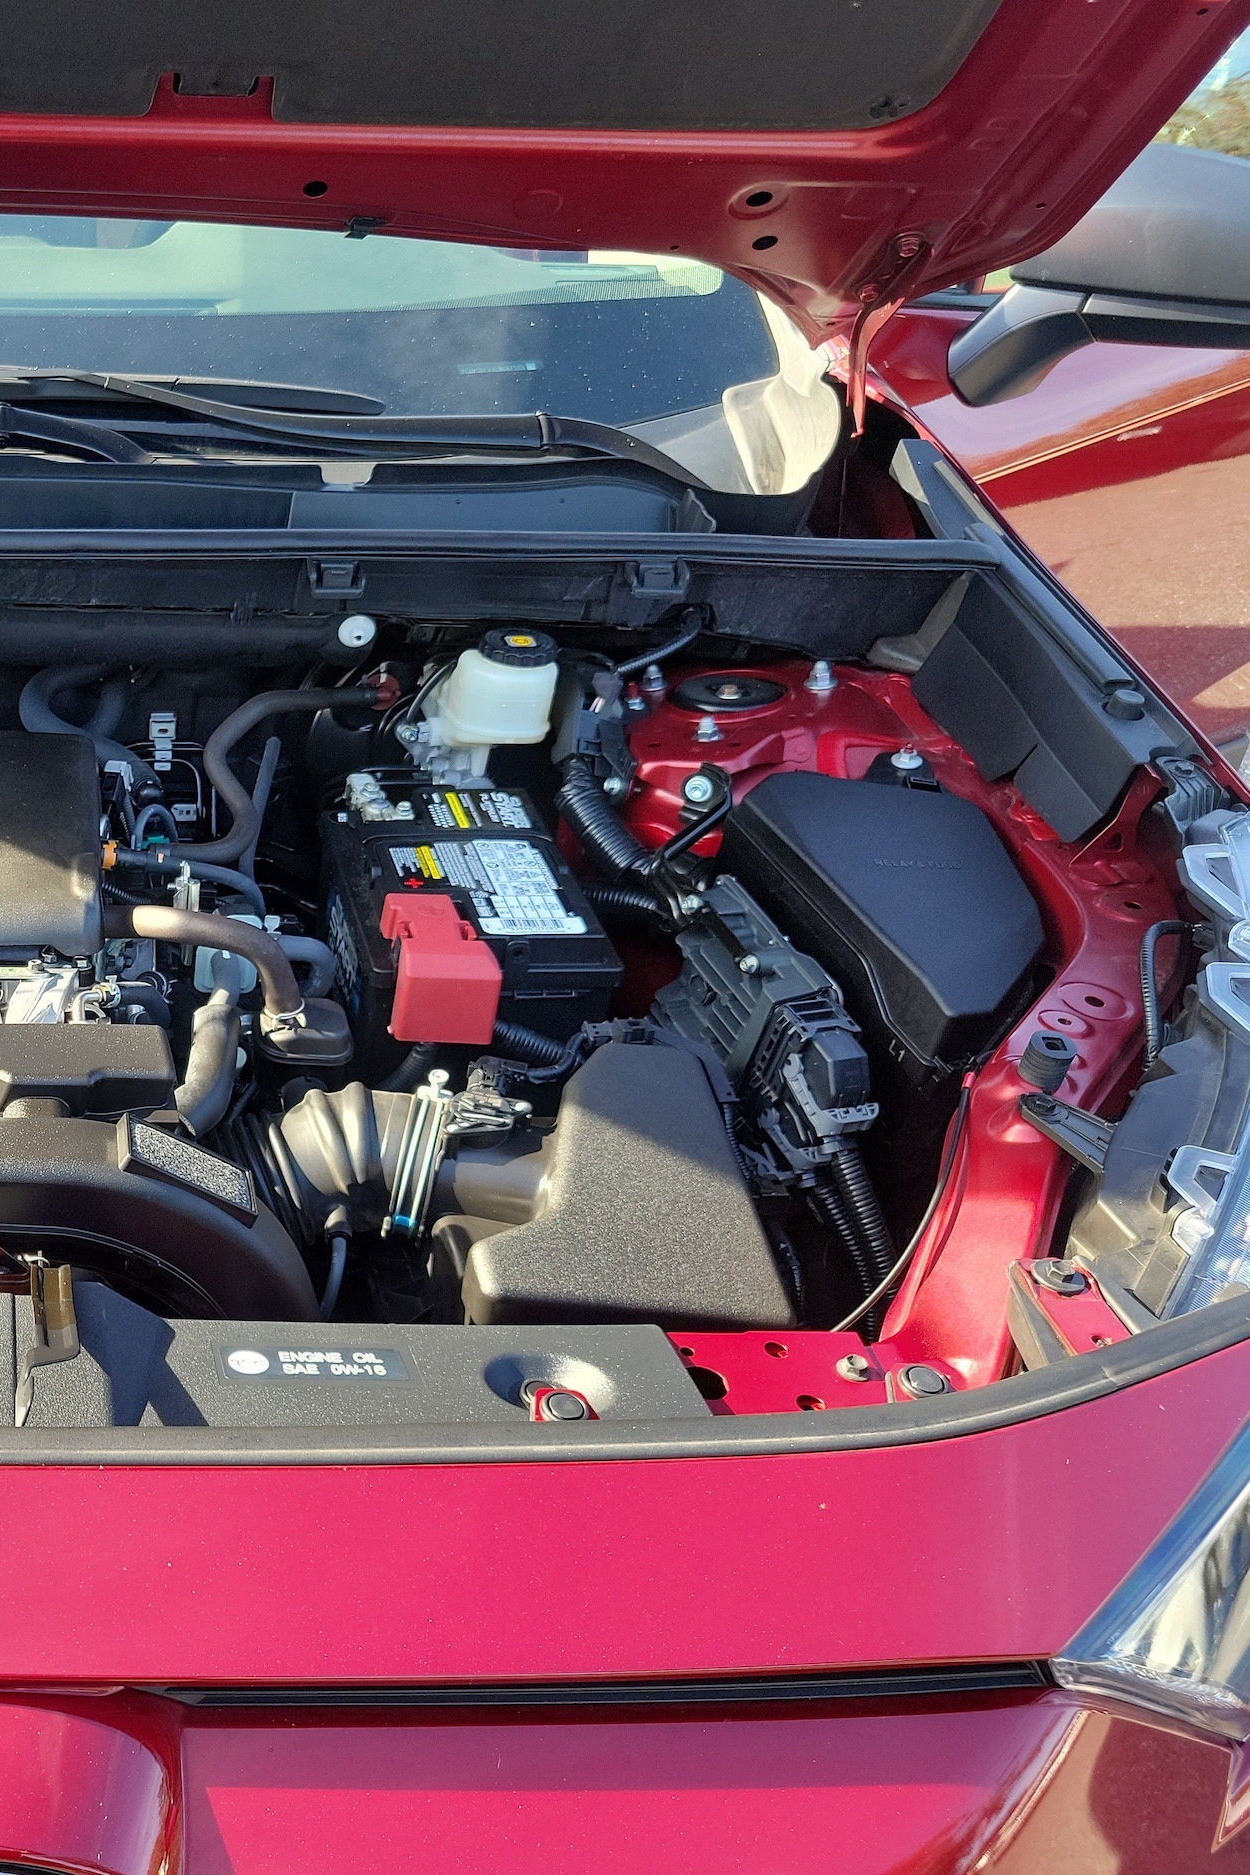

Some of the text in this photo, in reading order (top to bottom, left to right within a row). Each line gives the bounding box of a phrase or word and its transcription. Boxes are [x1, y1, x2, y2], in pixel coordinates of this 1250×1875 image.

[490, 791, 515, 828] START
[873, 859, 914, 870] RELAY
[888, 1040, 906, 1063] L1
[277, 1351, 384, 1364] ENGINE OIL
[282, 1364, 387, 1376] SAE 0W-16
